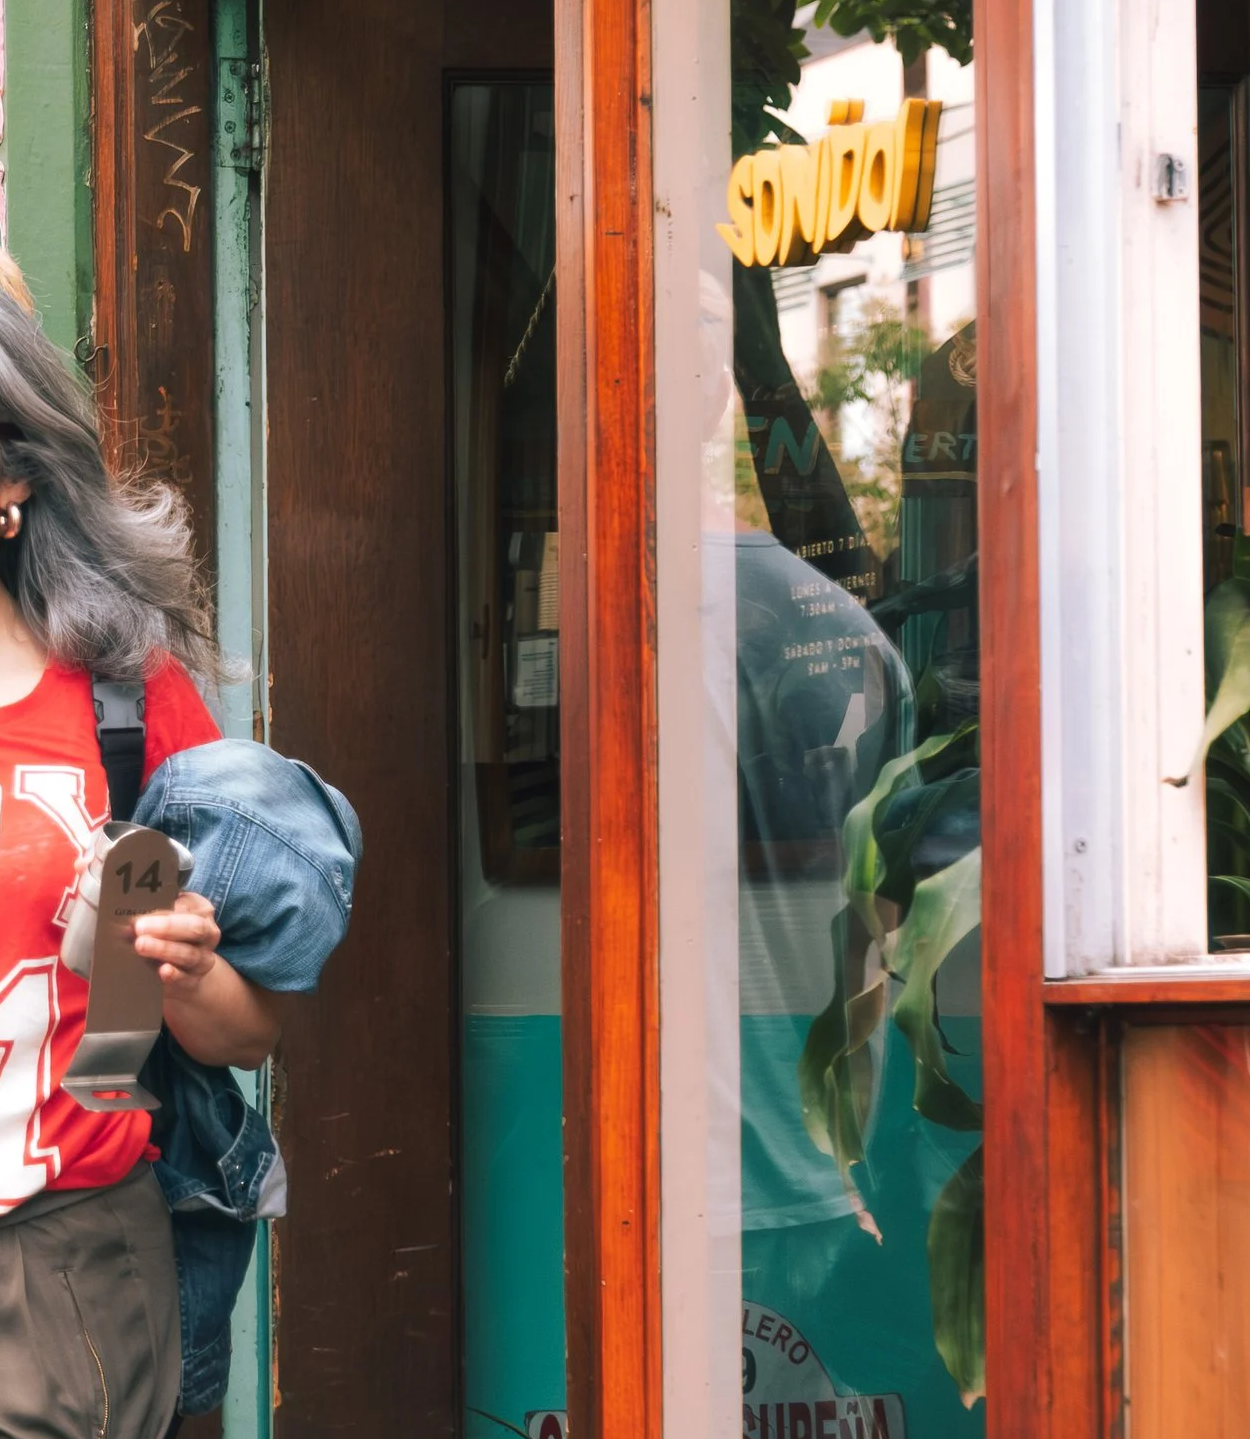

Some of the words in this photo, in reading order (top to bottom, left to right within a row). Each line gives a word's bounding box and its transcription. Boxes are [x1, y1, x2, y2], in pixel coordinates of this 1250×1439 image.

[795, 539, 834, 558] ABIERTO
[838, 537, 844, 552] 7
[790, 582, 820, 600] LUNES
[115, 859, 162, 895] 14
